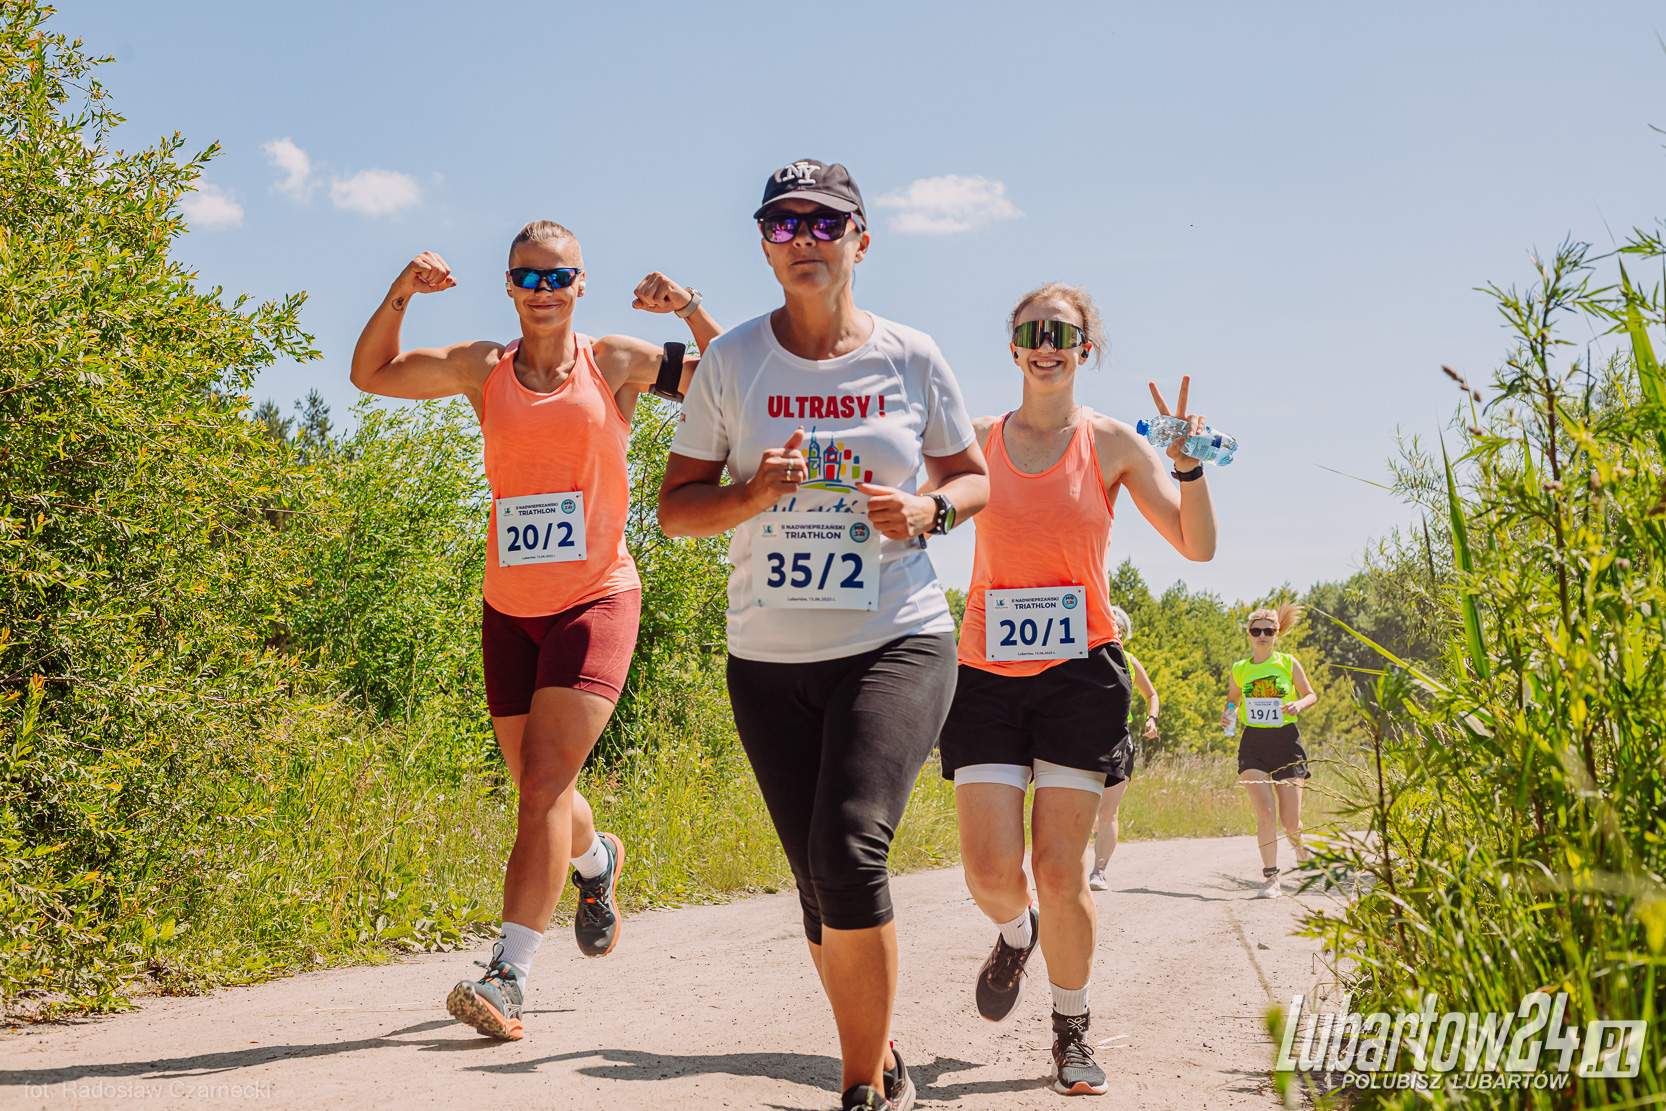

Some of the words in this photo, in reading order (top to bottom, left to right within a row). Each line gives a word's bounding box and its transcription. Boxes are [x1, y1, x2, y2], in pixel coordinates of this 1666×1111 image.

[782, 161, 821, 184] NY
[768, 395, 870, 419] ULTRASY
[518, 507, 556, 516] TRIATHLON
[506, 521, 576, 552] 20/2
[785, 531, 841, 540] TRIATHLON
[767, 552, 865, 590] 35/2
[1014, 602, 1057, 610] TRIATHLON
[1000, 617, 1076, 646] 20/1
[1250, 709, 1279, 720] 19/1
